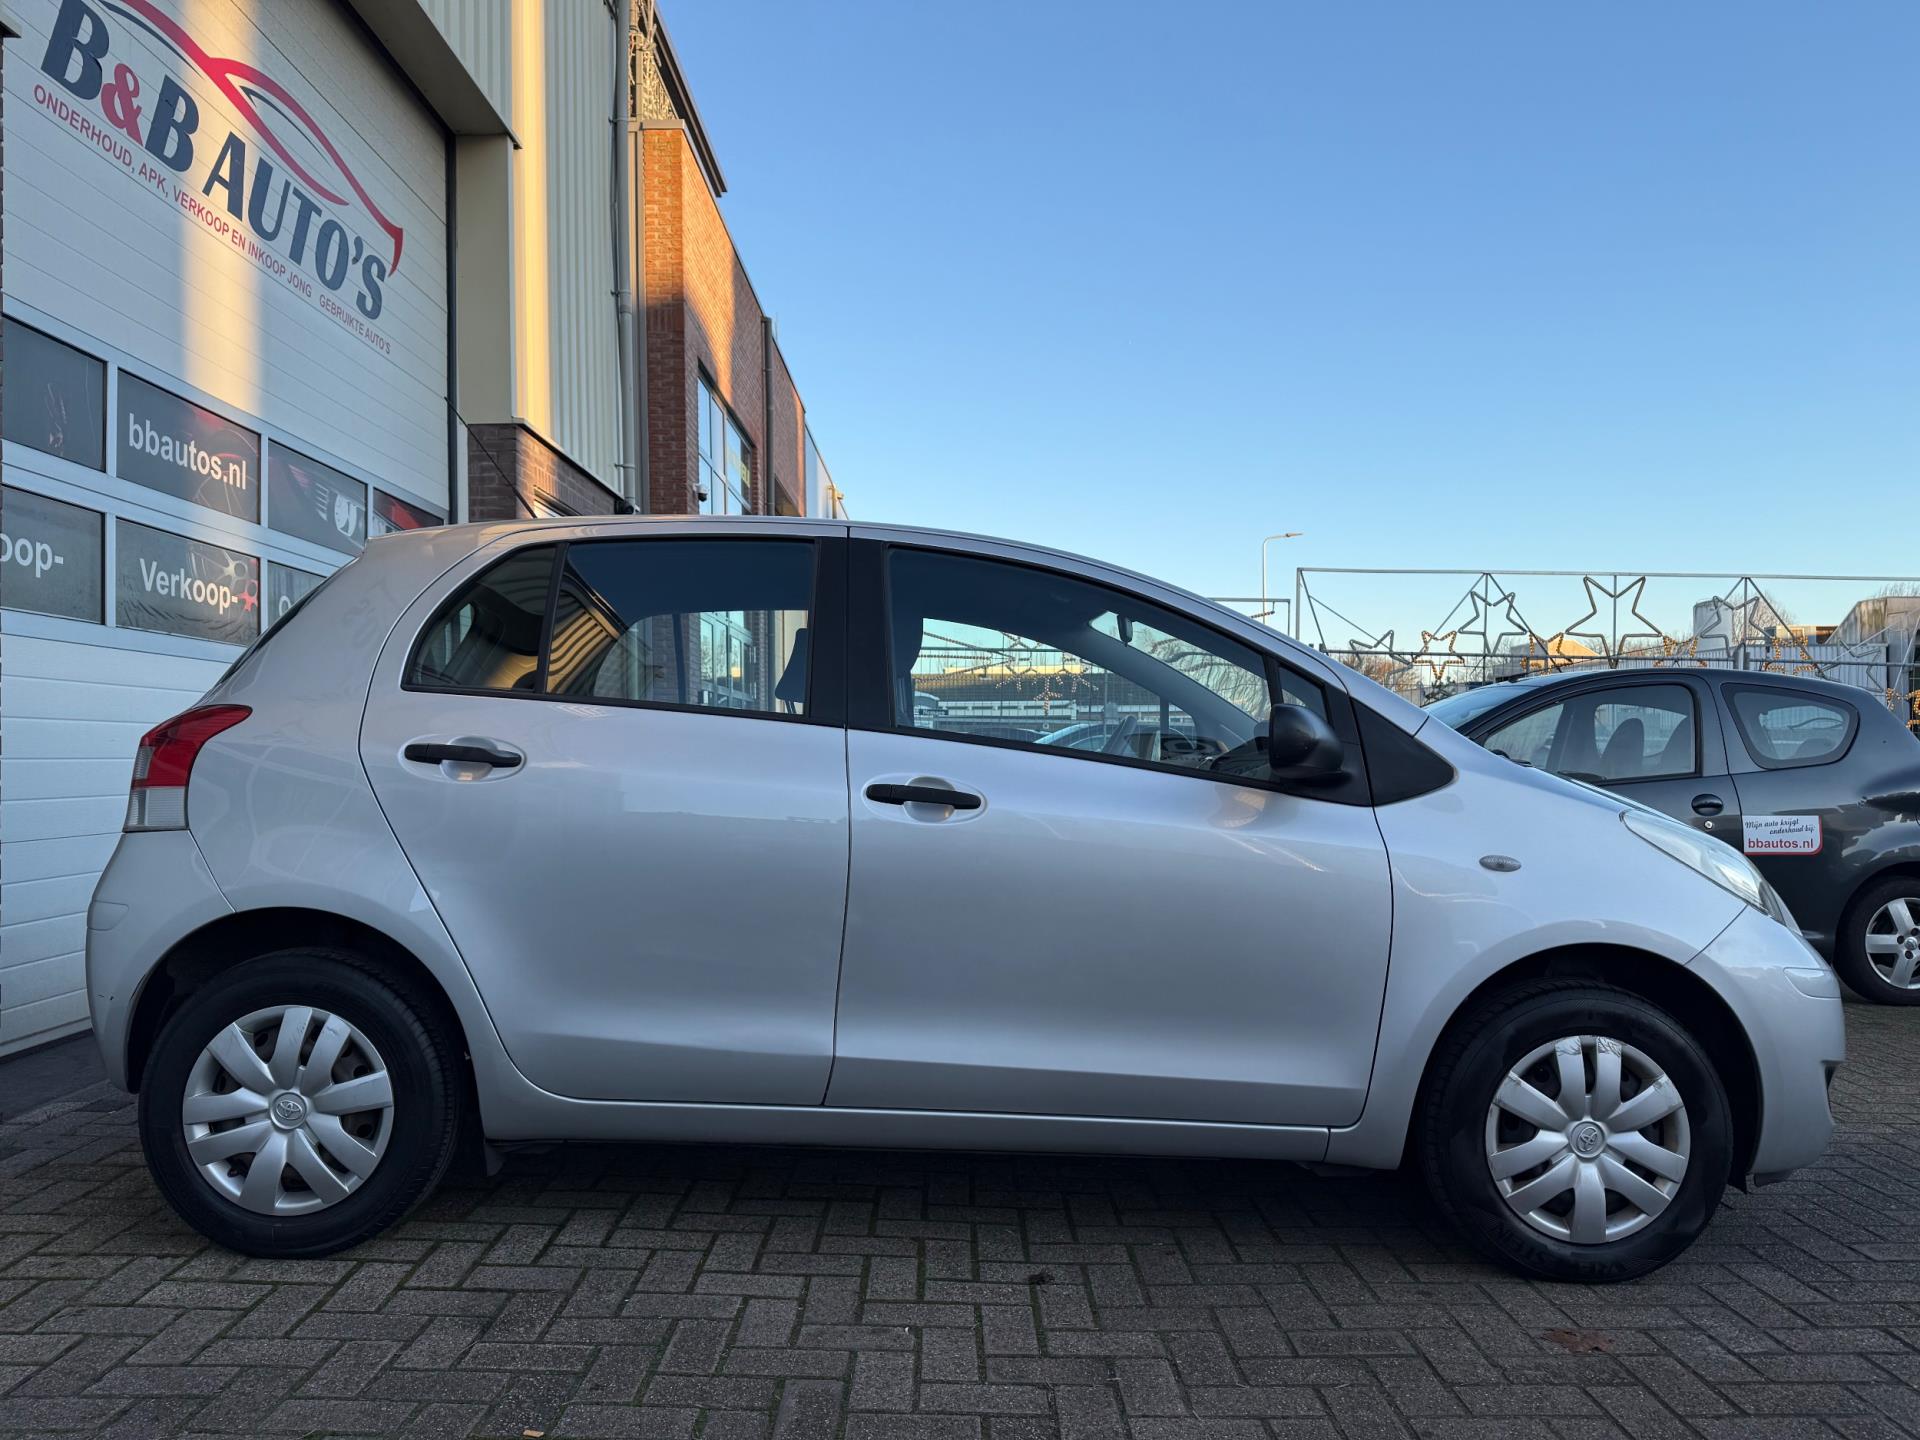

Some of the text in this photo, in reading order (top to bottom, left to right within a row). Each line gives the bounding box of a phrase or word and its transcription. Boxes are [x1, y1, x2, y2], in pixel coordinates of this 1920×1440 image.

[40, 0, 387, 320] B&B AUTO'S
[34, 84, 392, 355] ONDERHOUD, APK, VERKOOP EN INKOOP JONG GEBRUIKTE AUTO'S
[129, 413, 247, 490] bbautos.nl
[140, 558, 238, 615] Verkoop-
[1745, 818, 1799, 830] Mijn auto krijgt
[1748, 838, 1814, 849] bbautos.nl
[1769, 824, 1804, 835] onderhoud
